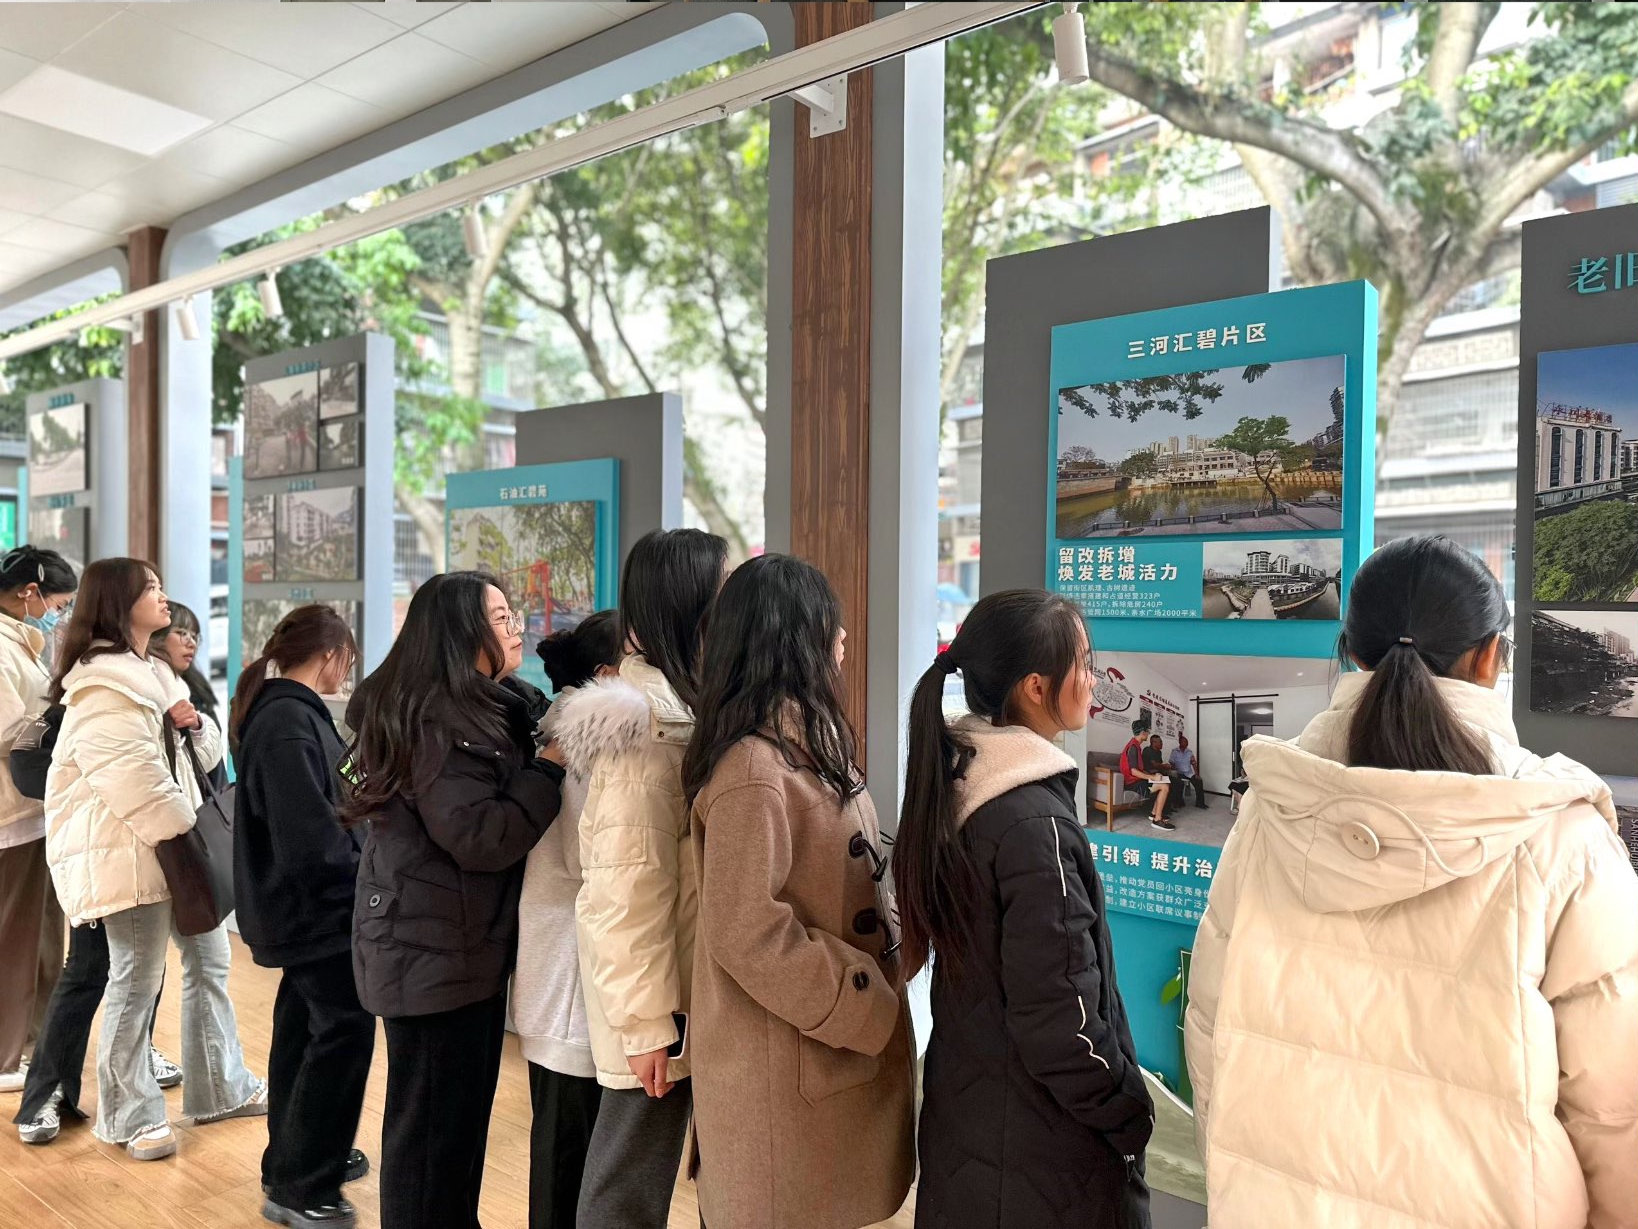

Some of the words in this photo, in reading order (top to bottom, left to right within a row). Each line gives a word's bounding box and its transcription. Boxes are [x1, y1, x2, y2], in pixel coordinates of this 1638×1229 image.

[1127, 322, 1267, 359] 三河汇碧片区
[1059, 546, 1135, 564] 留改拆增
[1058, 563, 1178, 581] 焕发老城活力
[1151, 851, 1213, 879] 提升治
